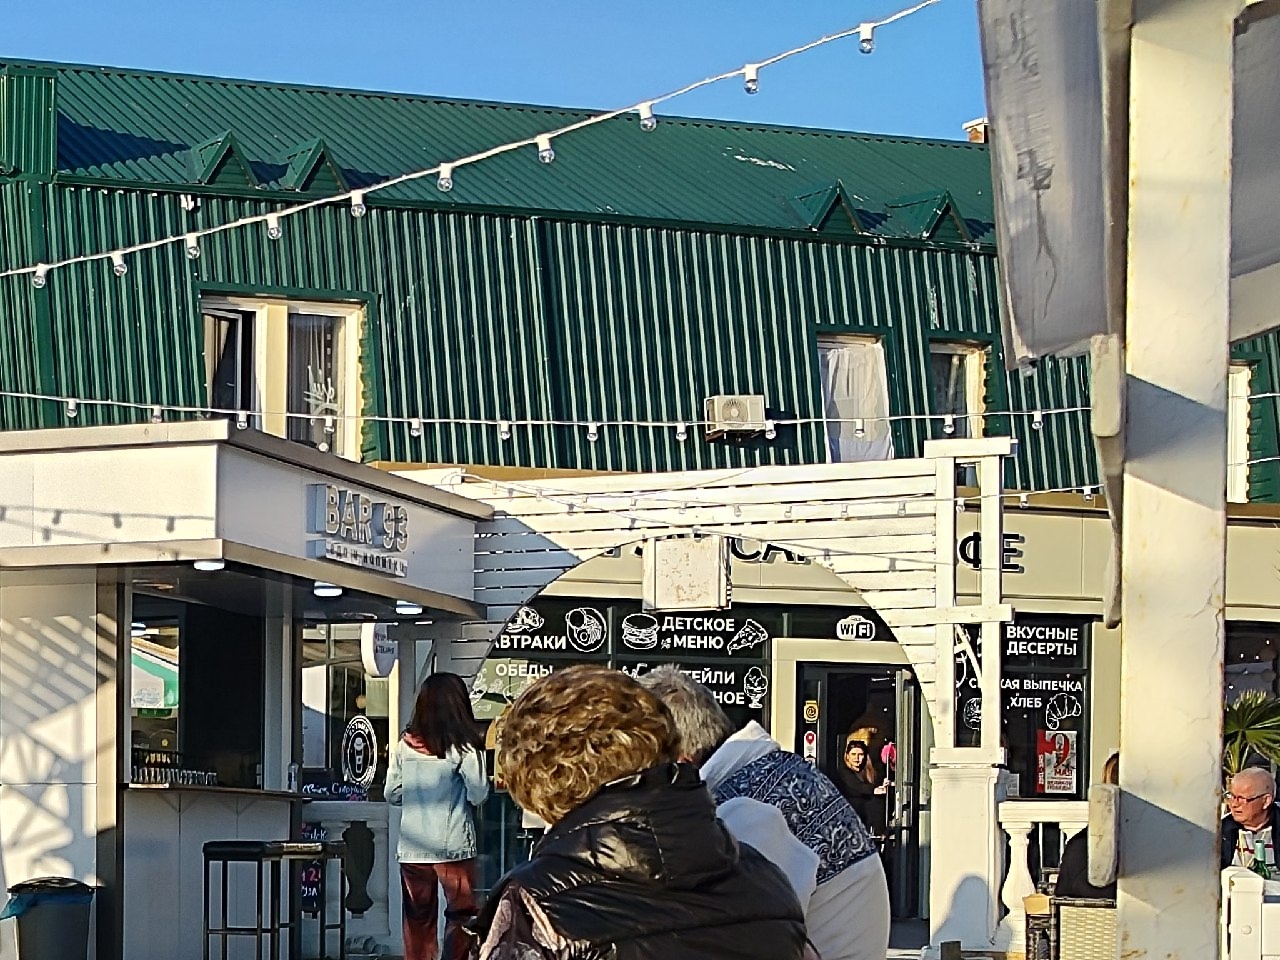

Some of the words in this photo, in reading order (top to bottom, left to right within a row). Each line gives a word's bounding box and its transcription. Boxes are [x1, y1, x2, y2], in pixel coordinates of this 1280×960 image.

[325, 485, 372, 544] BAR
[383, 503, 408, 552] 93
[662, 616, 735, 632] ДЕТСКОЕ
[1006, 626, 1078, 641] ВКУСНЫЕ
[494, 634, 567, 649] ВТРАКИ
[673, 635, 724, 650] МЕНЮ
[1006, 641, 1077, 656] ДЕСЕРТЫ
[495, 663, 554, 680] ОБЕДЫ
[1023, 679, 1083, 692] ВЫПЕЧКА
[1010, 696, 1043, 708] ХЛЕБ
